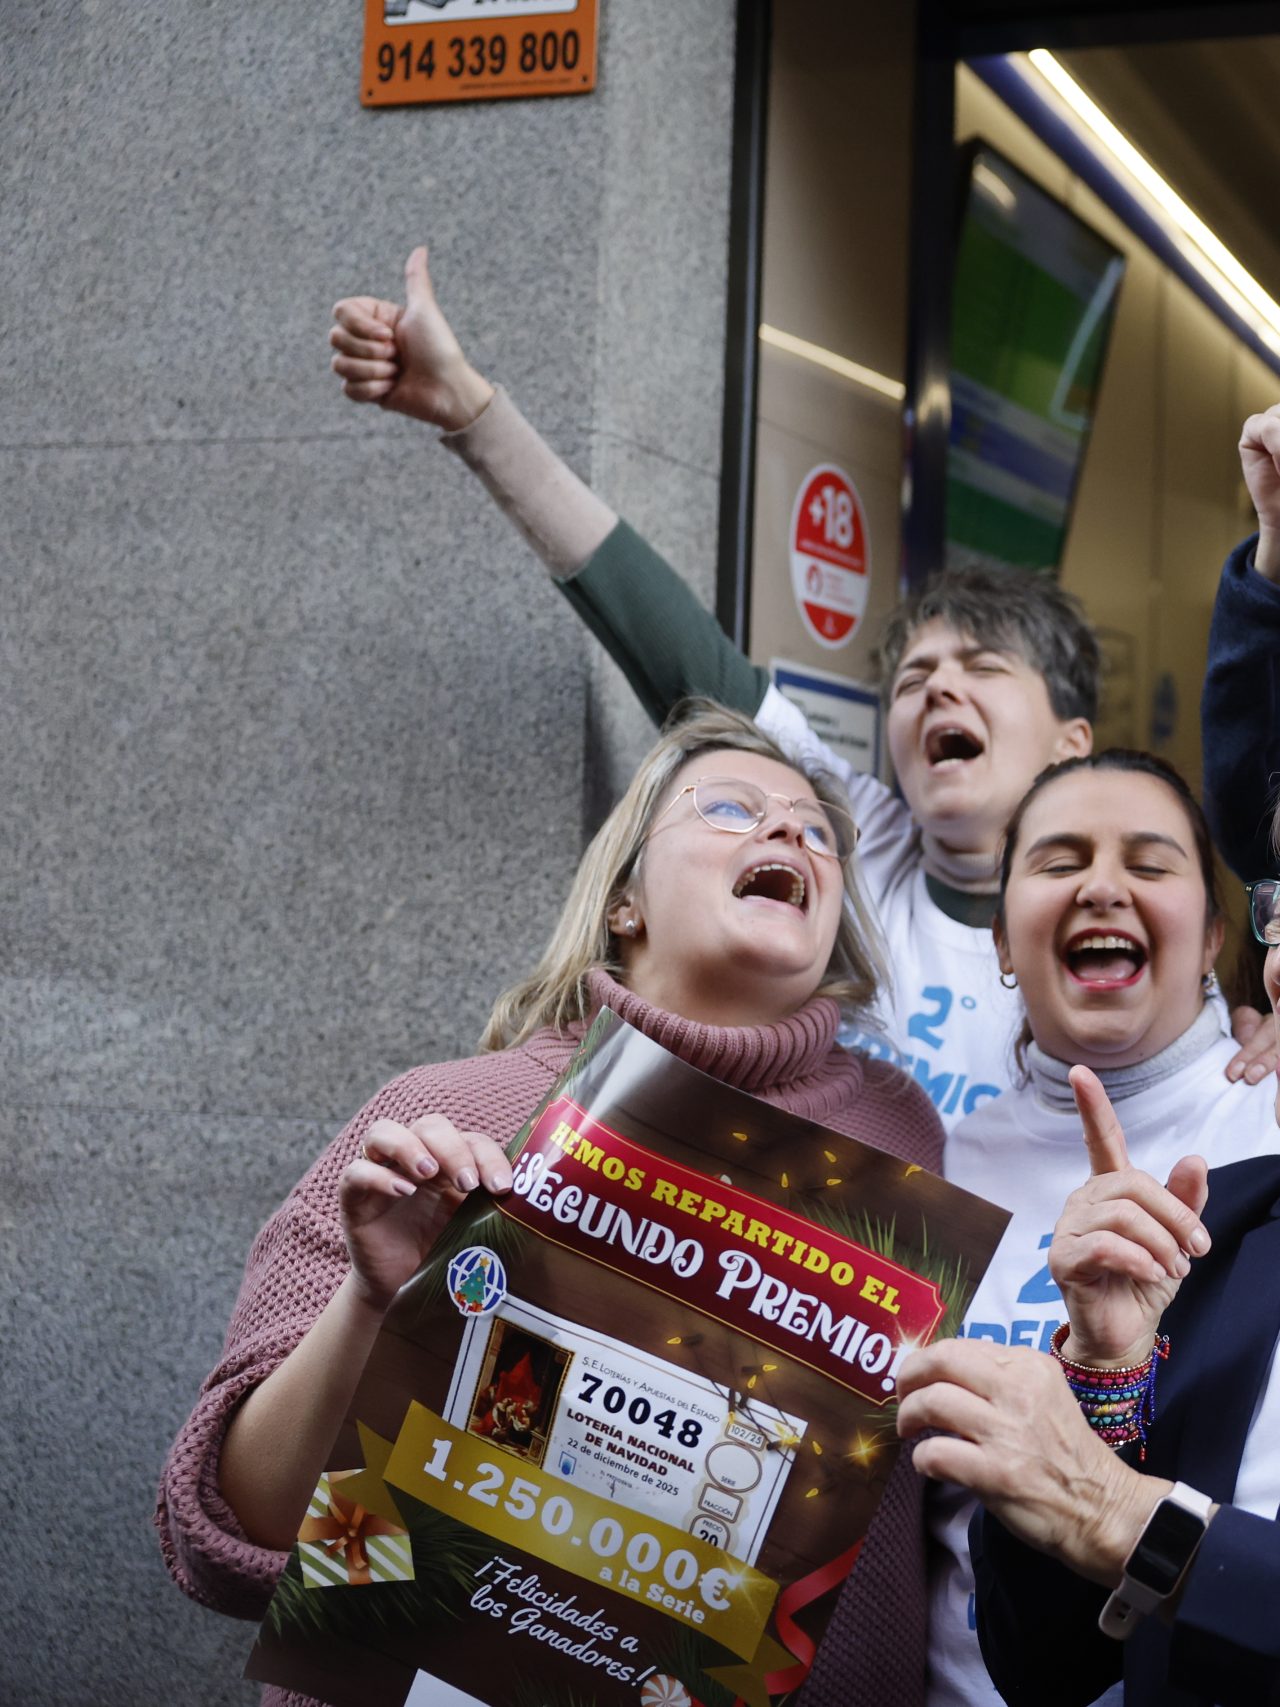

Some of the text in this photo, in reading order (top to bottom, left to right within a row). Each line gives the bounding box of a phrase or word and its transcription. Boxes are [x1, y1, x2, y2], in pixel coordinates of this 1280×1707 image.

[377, 29, 580, 82] 914 339 800
[808, 483, 854, 549] +18
[548, 1120, 901, 1315] HEMOS REPARTIDO EL
[511, 1152, 903, 1393] ¡SEGUNDO PREMIO!
[566, 1408, 696, 1474] LOTERÍA NACIONAL
[577, 1372, 703, 1448] 70048
[690, 1403, 721, 1424] ESTADO
[567, 1438, 579, 1449] 22
[580, 1445, 592, 1456] de
[593, 1451, 639, 1479] diciembre
[641, 1474, 654, 1485] de
[655, 1479, 680, 1497] 2025
[584, 1432, 668, 1477] DE NAVIDAD
[423, 1438, 738, 1611] 1.250.000€
[702, 1519, 723, 1533] PRECIO
[703, 1499, 734, 1517] FRACCIÓN
[473, 1555, 640, 1654] ¡Felicidades a
[600, 1565, 614, 1581] a
[617, 1566, 641, 1595] la
[509, 1609, 658, 1687] Ganadores!
